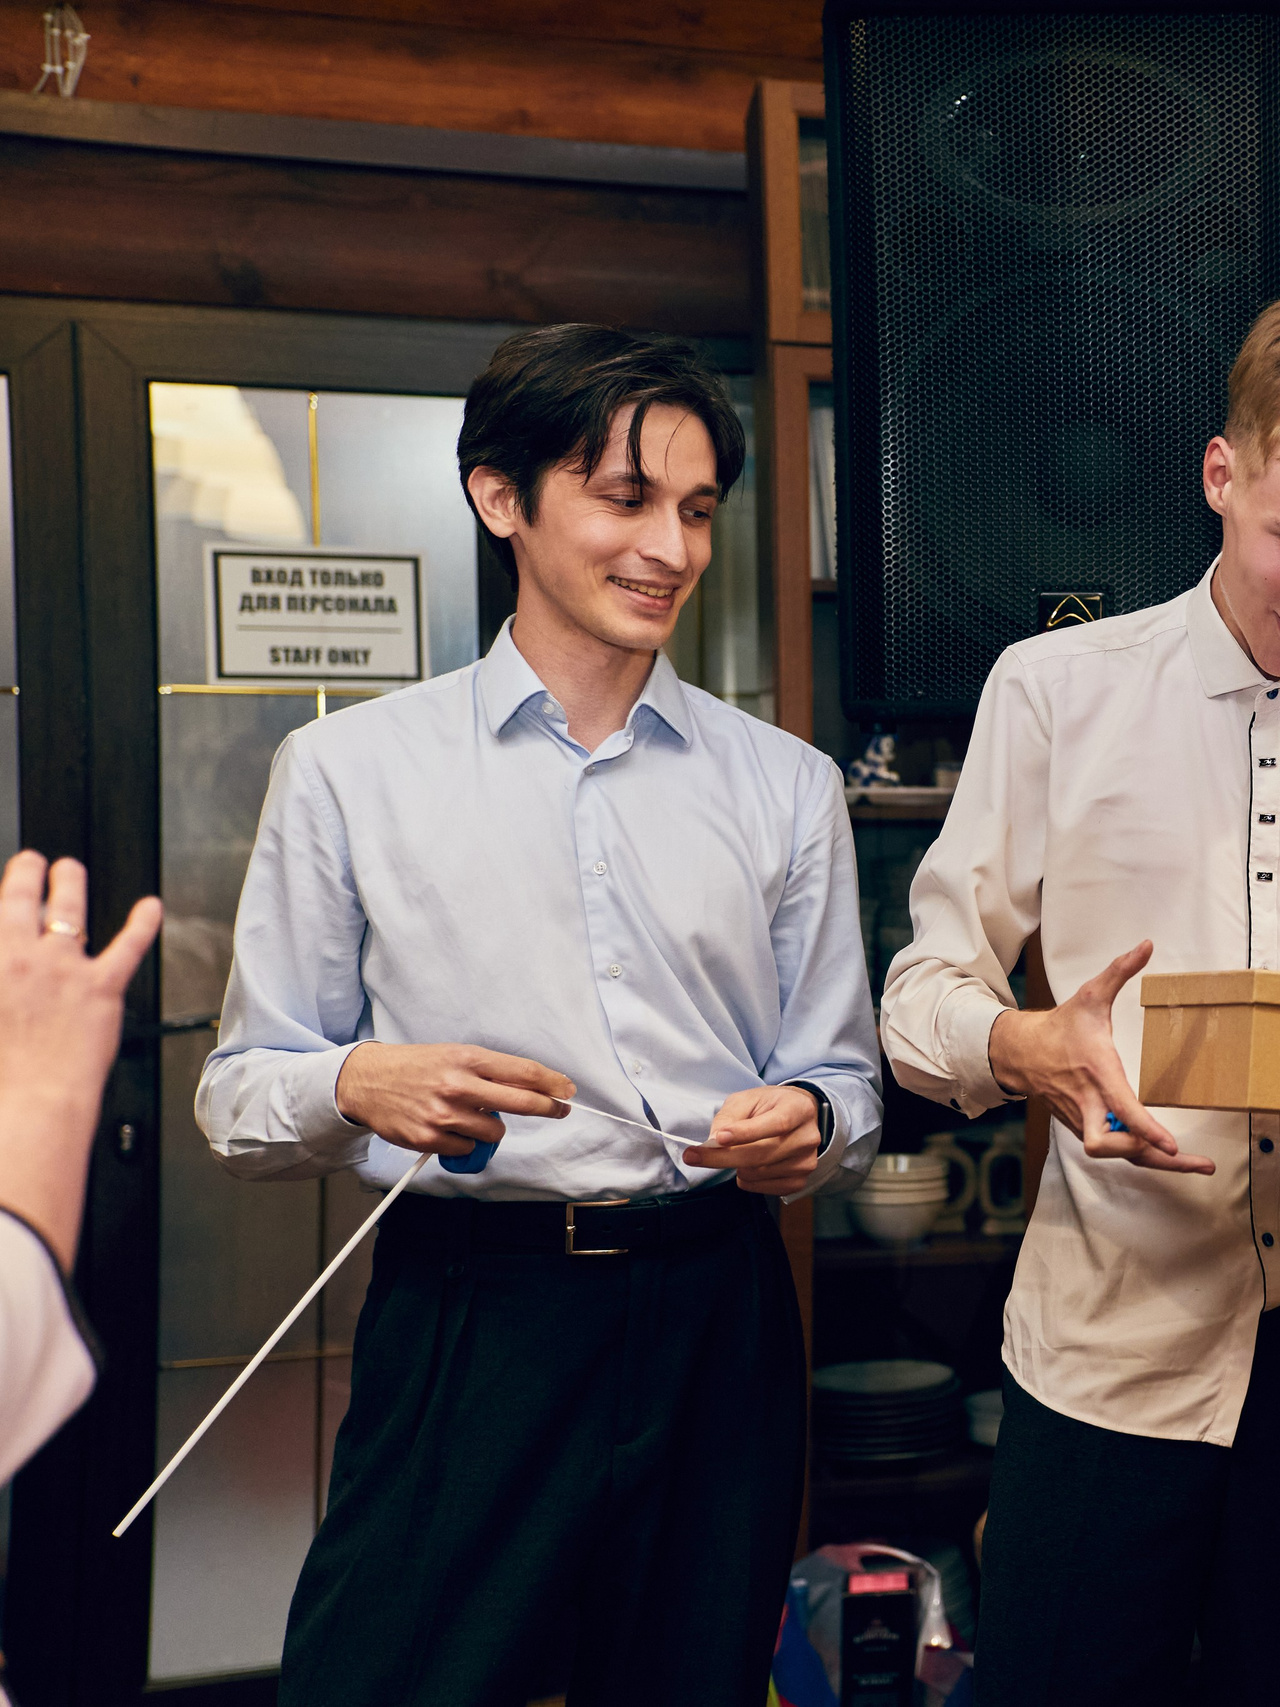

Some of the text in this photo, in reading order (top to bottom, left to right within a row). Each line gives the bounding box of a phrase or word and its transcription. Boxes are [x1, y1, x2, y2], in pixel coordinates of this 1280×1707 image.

[251, 567, 385, 588] ВХОД ТОЛЬКО
[238, 593, 398, 615] ДЛЯ ПЕРСОНАЛА
[269, 646, 372, 666] STAFF ONLY
